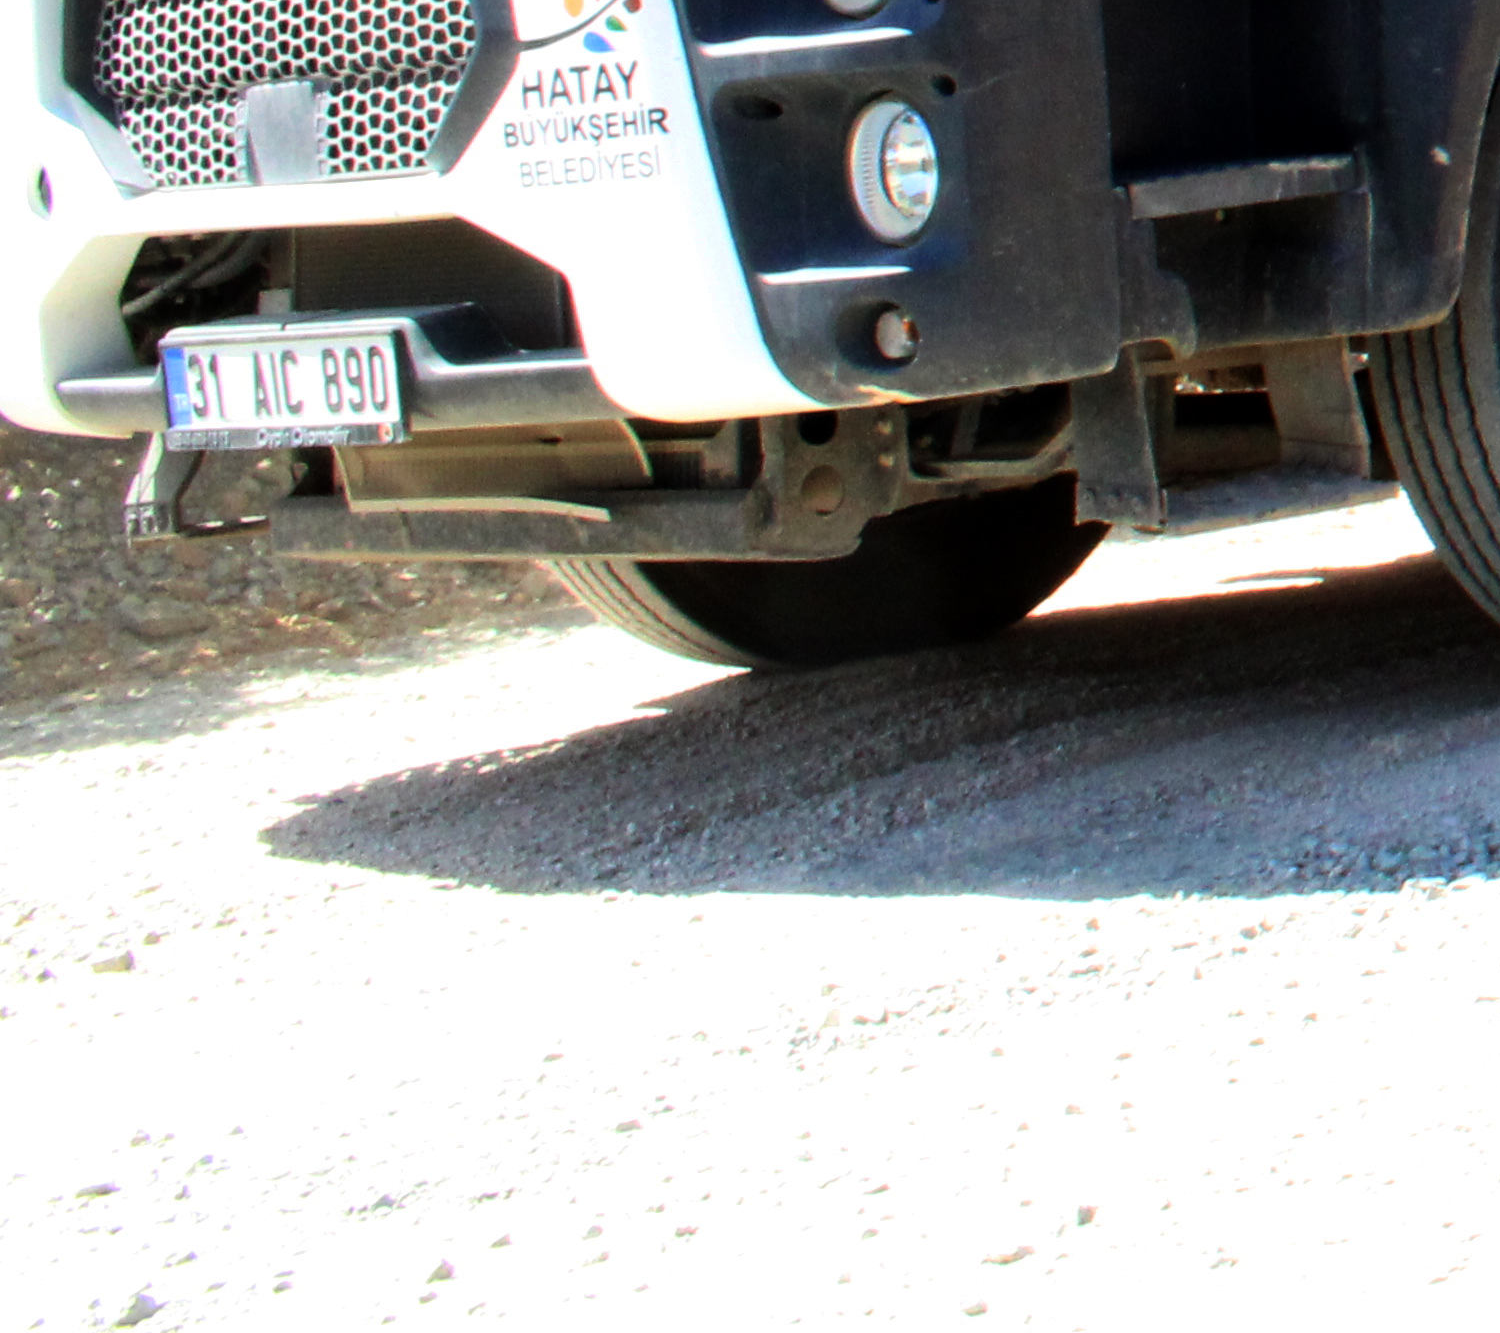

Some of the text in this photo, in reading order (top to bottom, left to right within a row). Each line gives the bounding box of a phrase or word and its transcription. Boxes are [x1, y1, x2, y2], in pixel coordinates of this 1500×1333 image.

[522, 60, 638, 110] HATAY
[503, 102, 671, 148] BÜYÜKŞEHİR
[519, 144, 662, 188] BELEDİYESİ
[187, 345, 391, 421] 31 AIC 890
